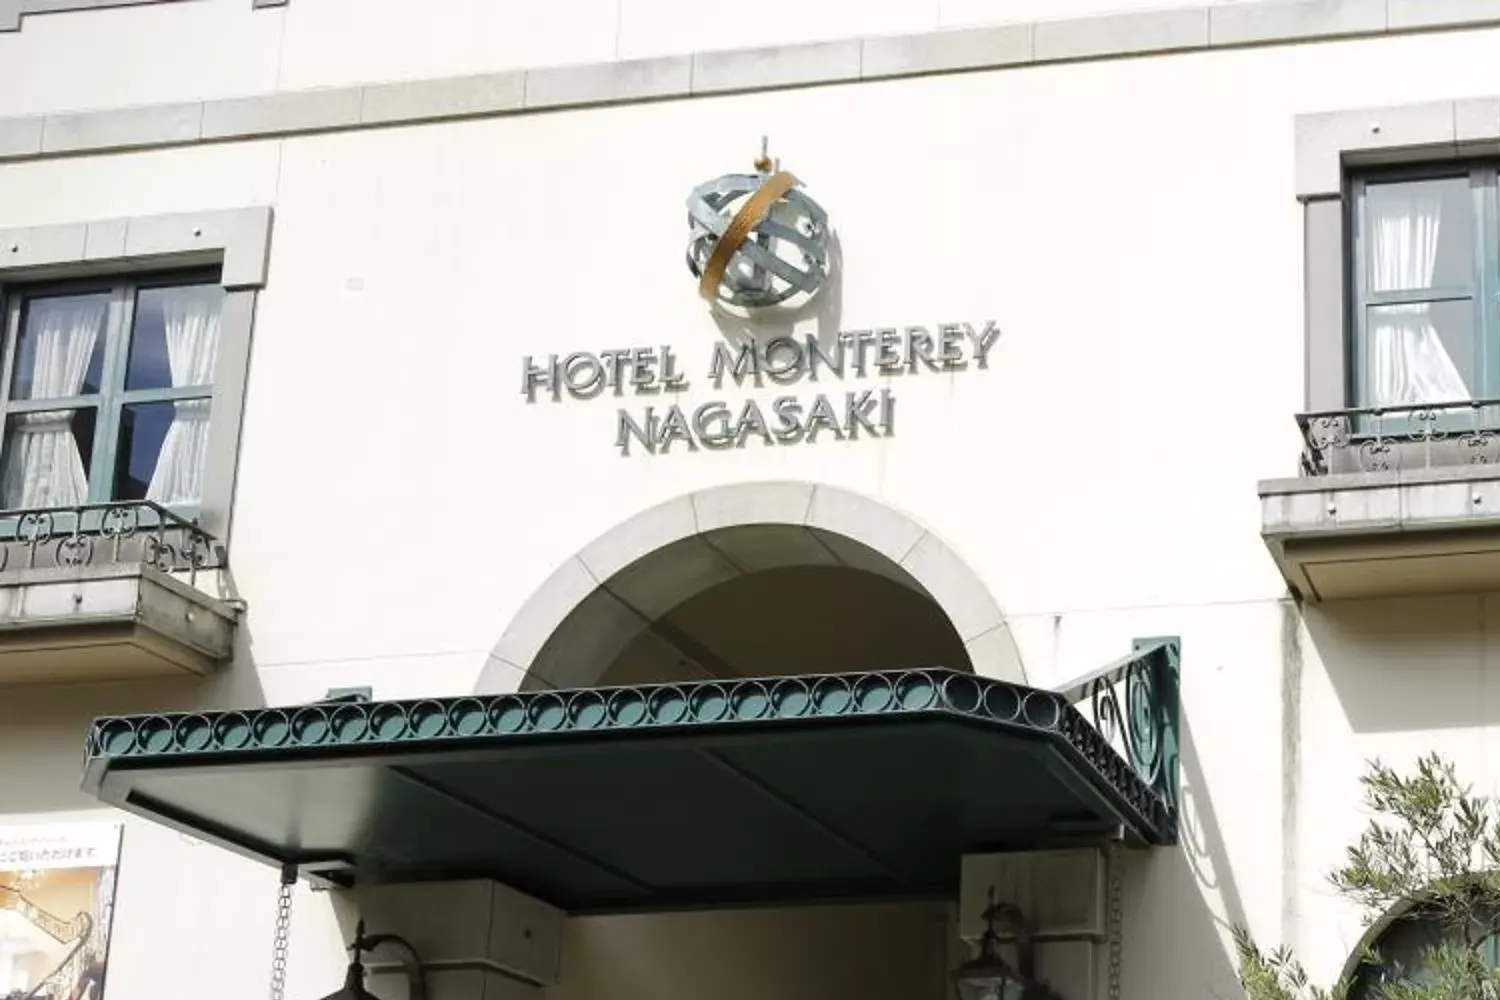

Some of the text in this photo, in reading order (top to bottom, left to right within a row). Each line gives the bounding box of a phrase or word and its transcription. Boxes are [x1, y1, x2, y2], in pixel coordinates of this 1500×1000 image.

[522, 319, 1001, 403] HOTEL MONTEREY
[615, 386, 897, 457] NAGASAKI
